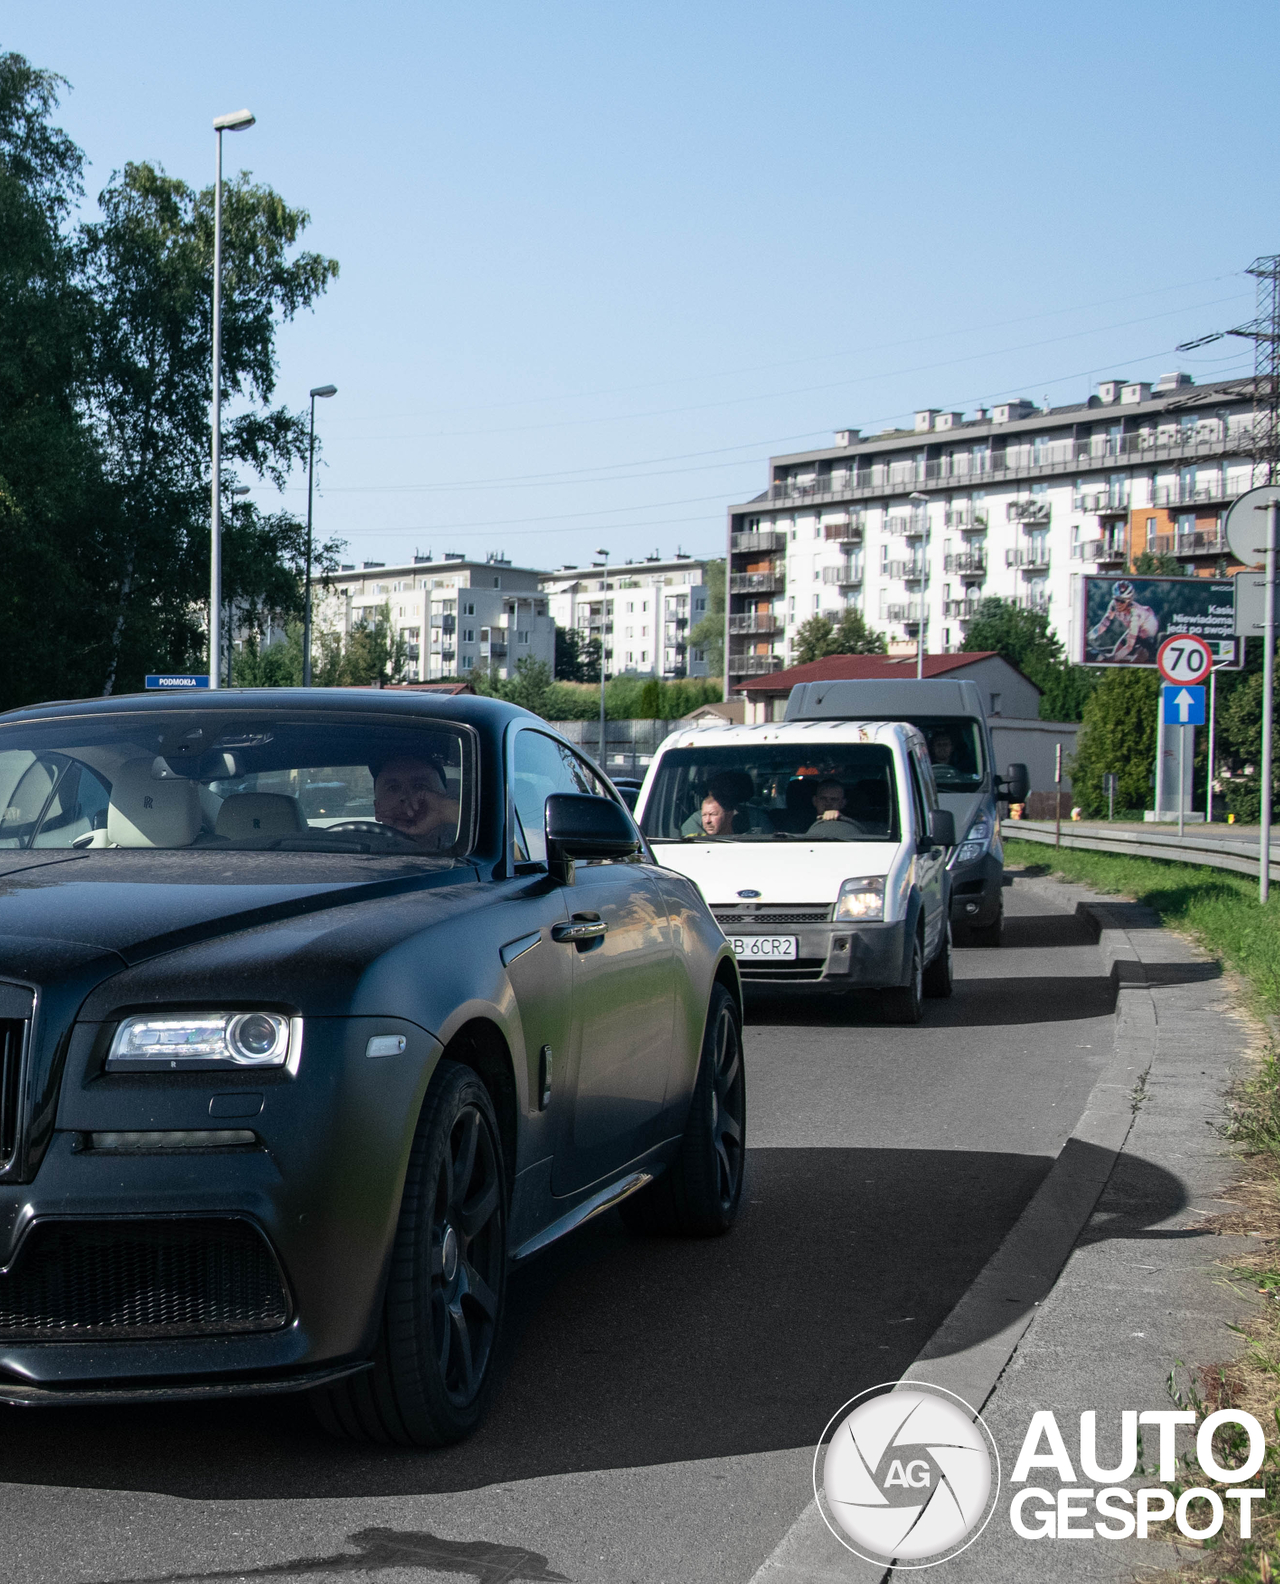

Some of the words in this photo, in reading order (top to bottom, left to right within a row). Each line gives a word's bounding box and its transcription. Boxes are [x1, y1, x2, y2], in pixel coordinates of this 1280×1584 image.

[1189, 626, 1202, 635] po
[1170, 647, 1205, 673] 70
[159, 678, 196, 686] PODMOKŁA
[751, 939, 792, 954] 6CR2
